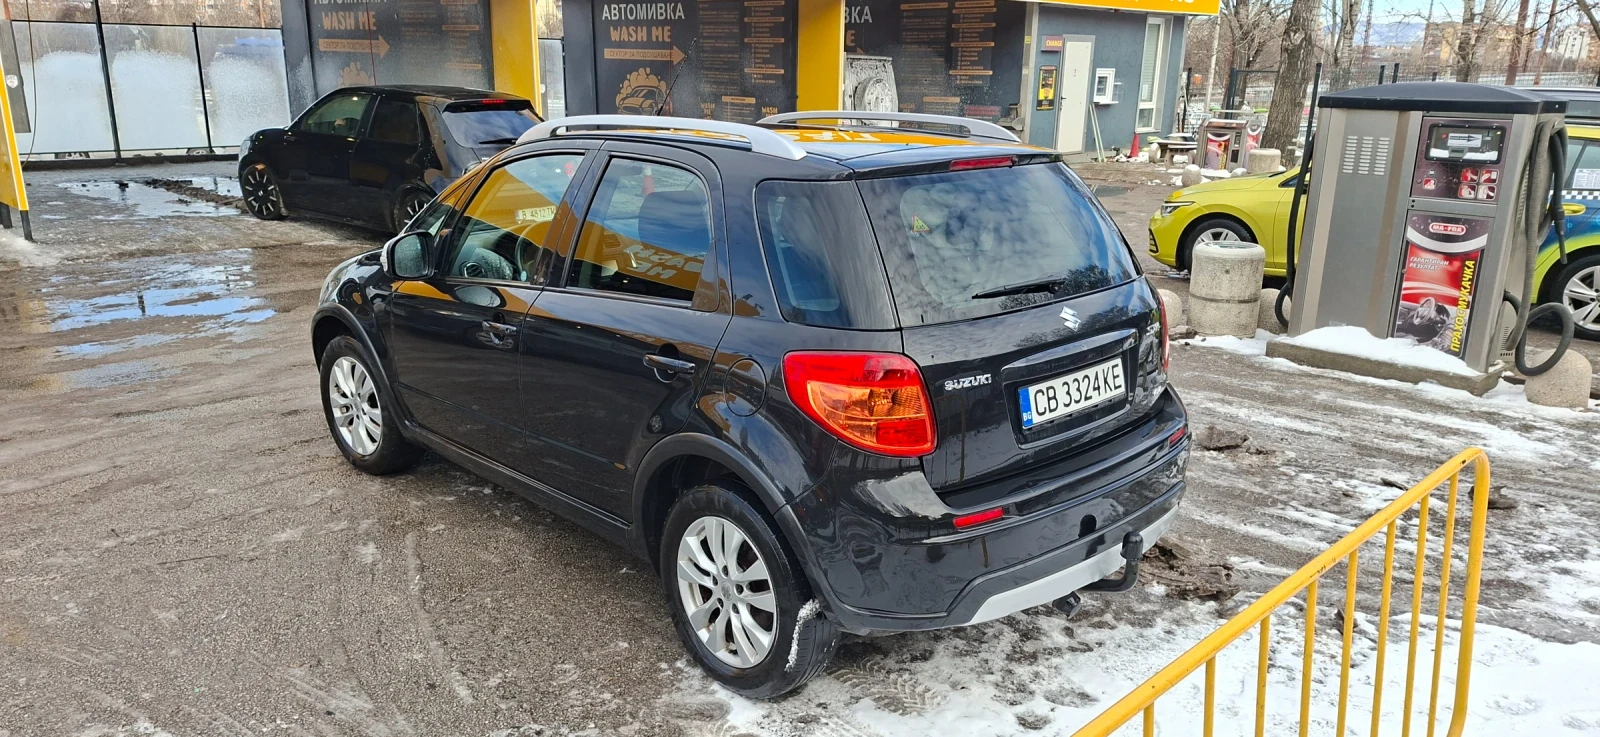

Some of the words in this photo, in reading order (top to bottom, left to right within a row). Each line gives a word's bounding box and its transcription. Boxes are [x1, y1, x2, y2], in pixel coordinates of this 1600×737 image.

[602, 3, 685, 20] АВТОМИВКА
[322, 11, 355, 30] WASH
[359, 11, 377, 30] ME
[610, 26, 647, 42] WASH
[652, 26, 671, 42] ME
[609, 50, 627, 58] СЕКТОР
[1409, 262, 1439, 270] РЕЗУЛТАТ
[1450, 260, 1475, 352] ПРАХОСМУКАЧКА
[944, 373, 992, 391] SUZUKI
[1034, 385, 1059, 416] CB
[1062, 370, 1101, 408] 3324
[1102, 363, 1122, 394] KE
[1023, 411, 1032, 421] BG
